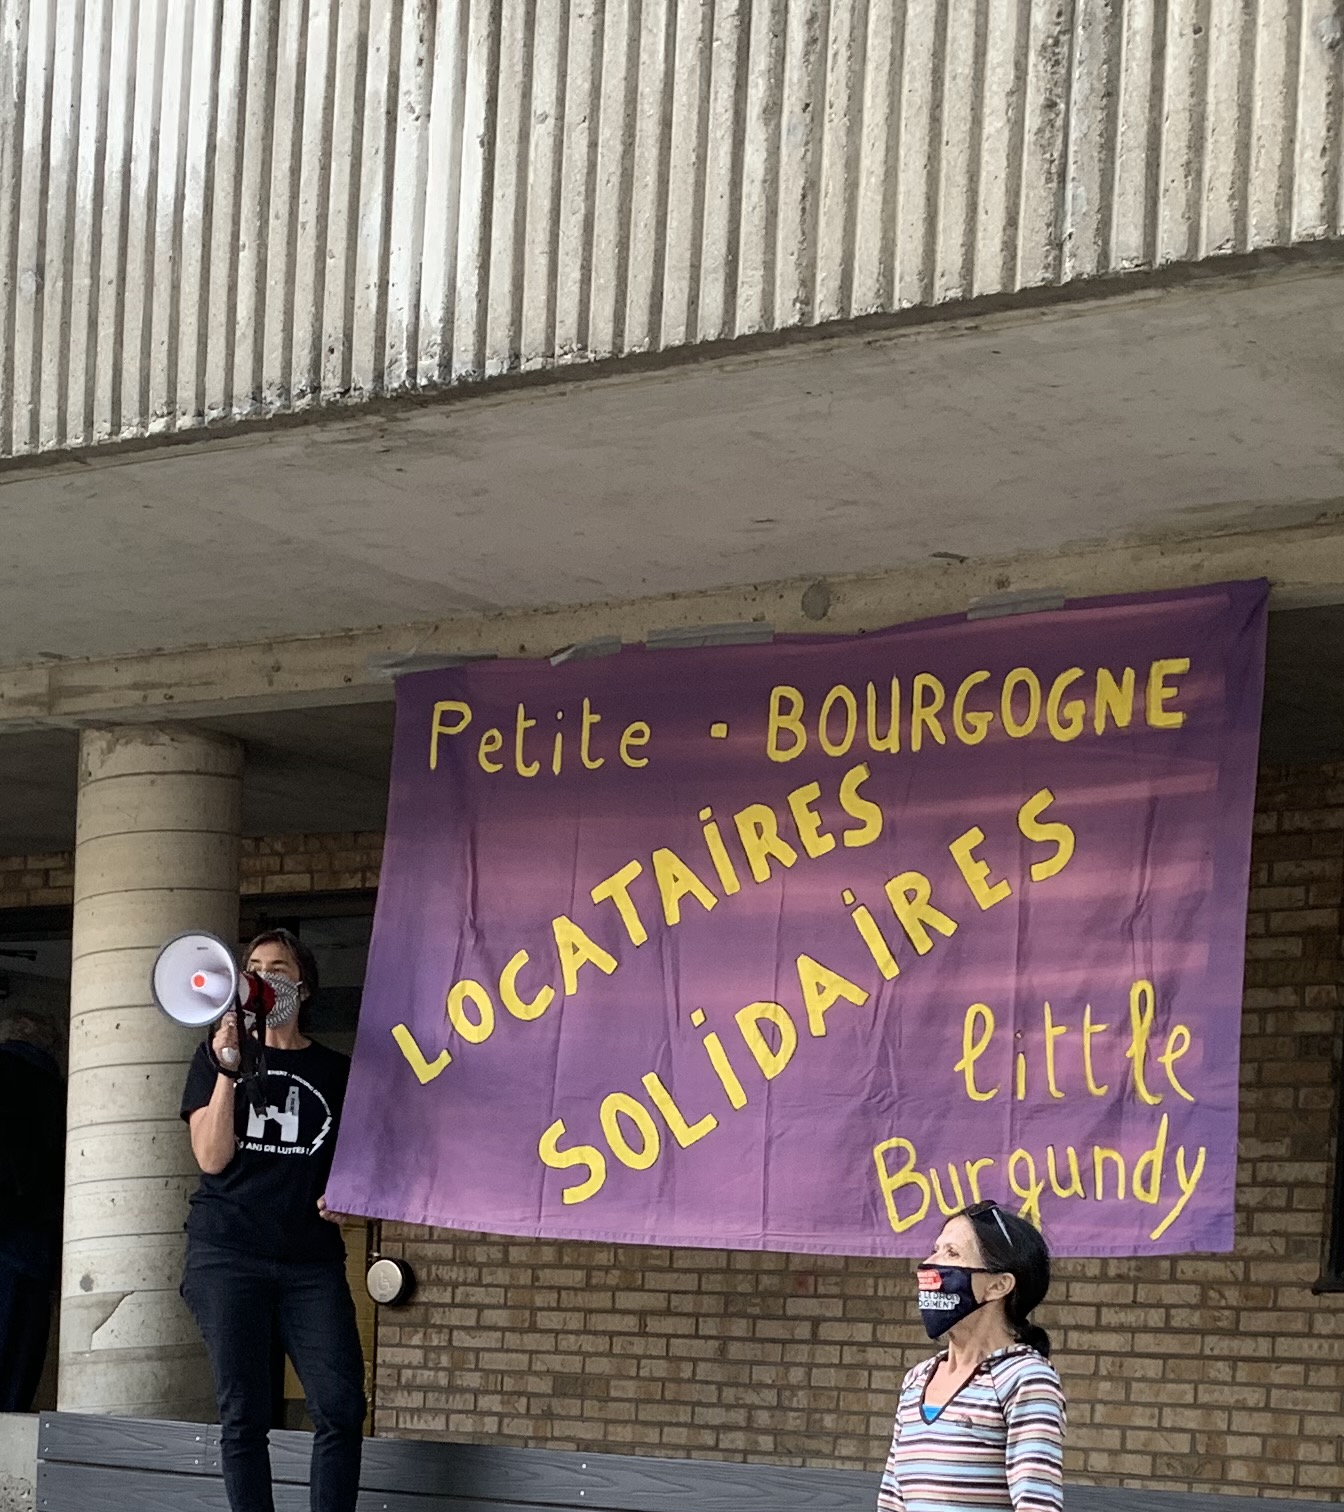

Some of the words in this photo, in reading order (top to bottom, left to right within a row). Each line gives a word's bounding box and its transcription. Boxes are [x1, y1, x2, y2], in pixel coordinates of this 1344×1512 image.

[429, 697, 651, 778] Petite
[765, 657, 1191, 764] BOURGOGNE
[872, 1112, 1207, 1241] Burgundy
